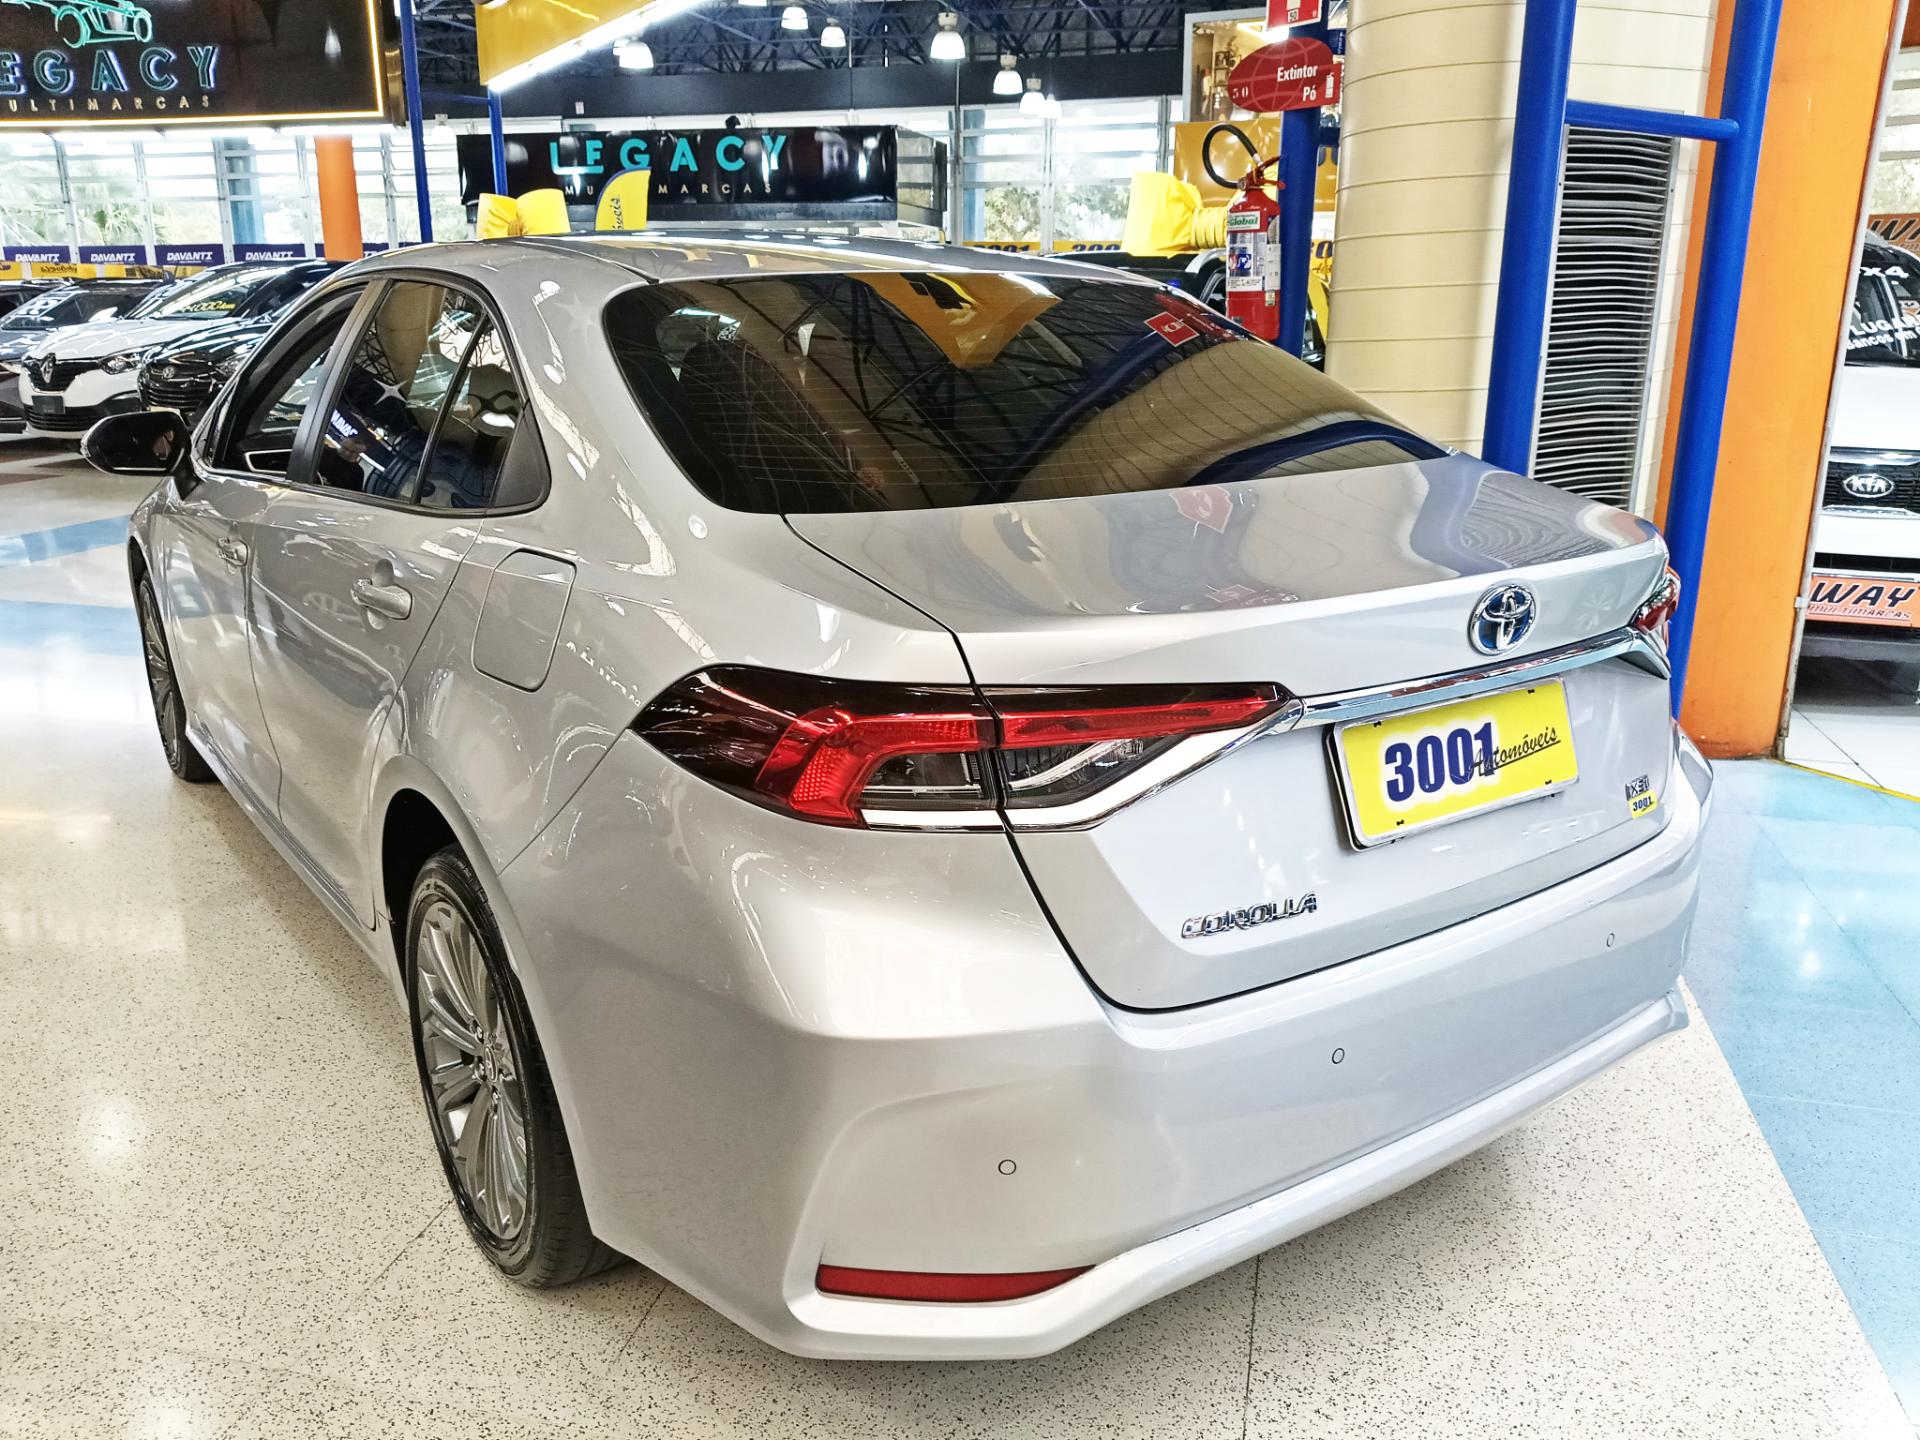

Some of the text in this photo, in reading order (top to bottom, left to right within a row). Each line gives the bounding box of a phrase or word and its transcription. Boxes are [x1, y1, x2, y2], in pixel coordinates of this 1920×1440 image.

[0, 45, 219, 95] EGACY
[1277, 64, 1318, 82] Extintor
[1302, 84, 1317, 101] Pó
[8, 95, 210, 113] ULTIMARCAS
[550, 135, 787, 175] LEGACY
[565, 183, 772, 195] MUMARCAS
[15, 253, 60, 262] DAVANTI
[90, 252, 136, 262] DAVANTI
[166, 251, 213, 261] DAVANTI
[1858, 265, 1910, 279] x4
[1850, 476, 1887, 493] KIA
[1810, 581, 1916, 608] WAY
[1385, 721, 1561, 803] 3001 Automóveis
[1632, 795, 1653, 812] 3001
[1181, 891, 1318, 939] COROLLA
